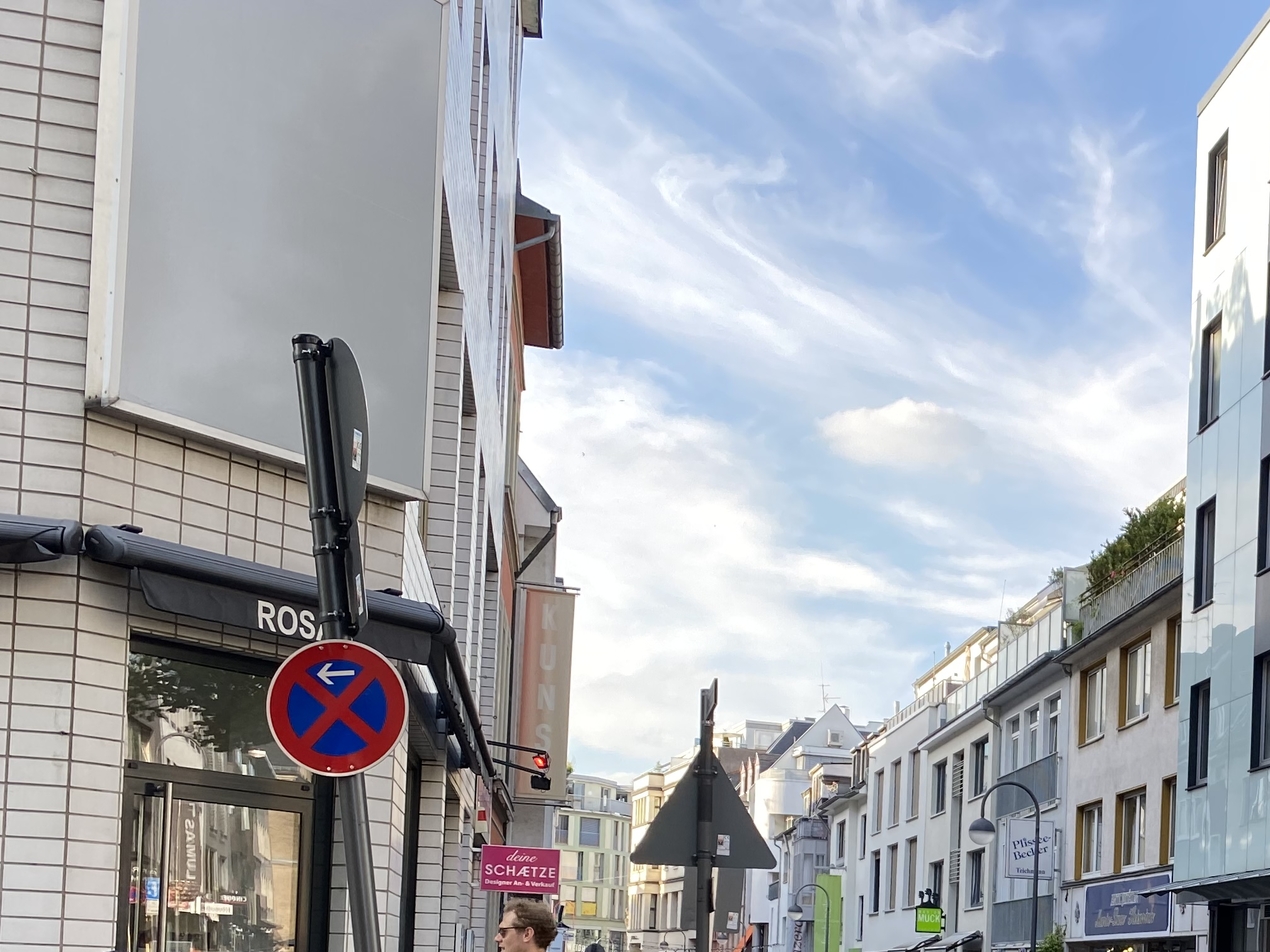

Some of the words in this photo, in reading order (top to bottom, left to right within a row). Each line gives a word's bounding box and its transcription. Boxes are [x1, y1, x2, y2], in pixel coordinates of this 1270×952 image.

[506, 849, 538, 863] deine
[484, 863, 556, 878] SCHÆTZE
[484, 878, 513, 886] Designer
[918, 914, 940, 923] MUCK
